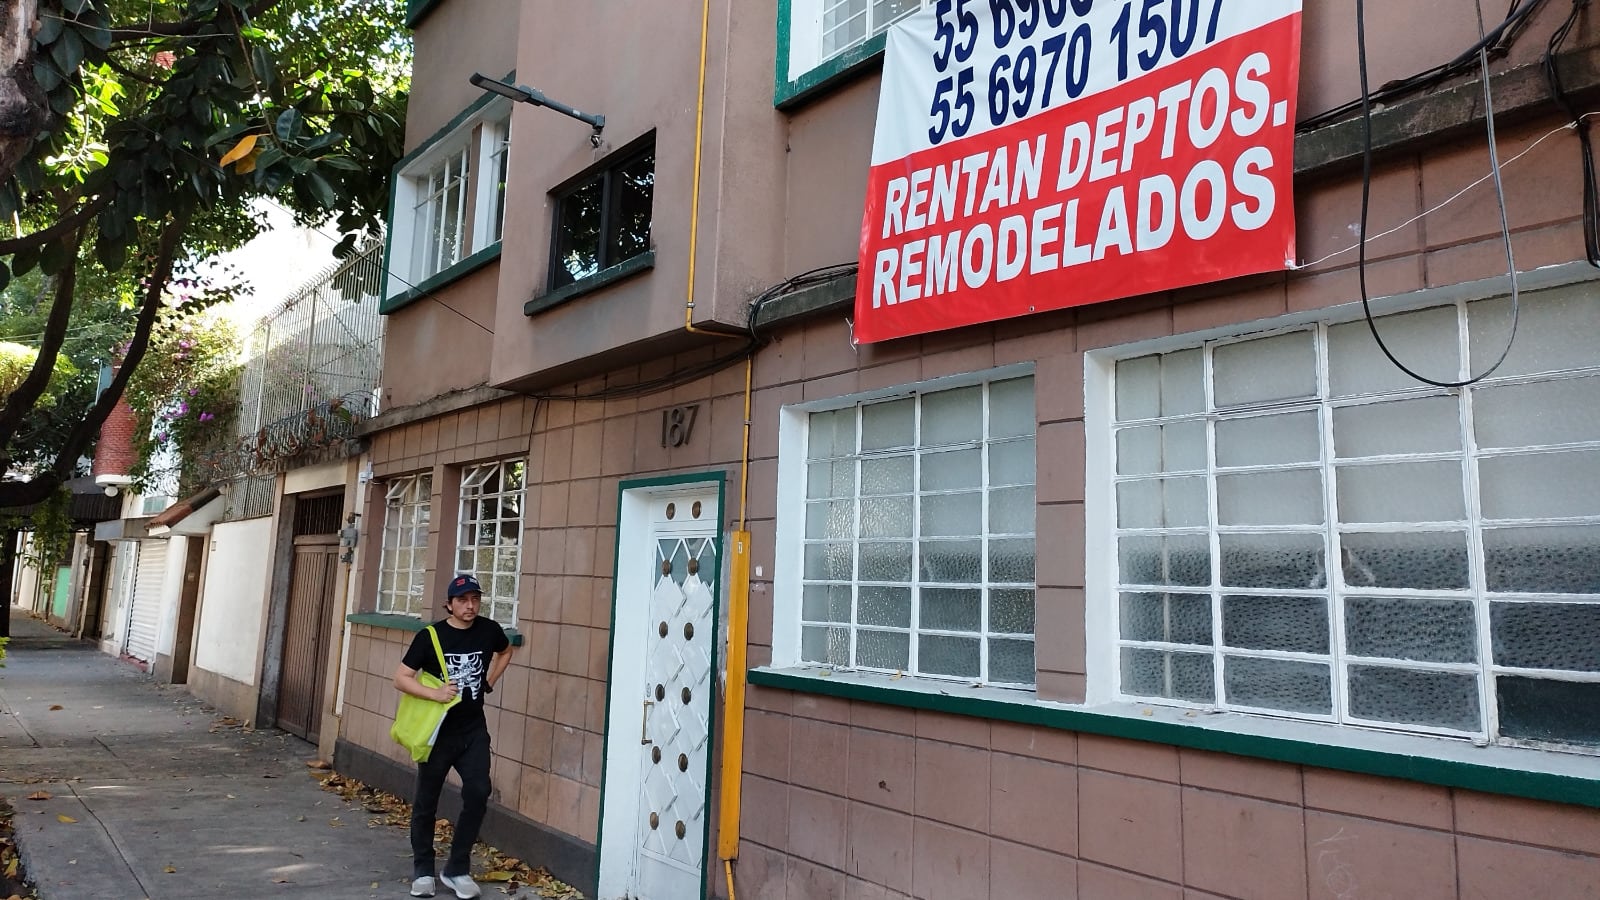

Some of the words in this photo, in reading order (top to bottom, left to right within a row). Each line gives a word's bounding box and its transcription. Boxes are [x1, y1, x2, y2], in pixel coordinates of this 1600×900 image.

[928, 66, 976, 145] 55
[987, 22, 1092, 127] 6970
[1109, 0, 1223, 82] 1507
[933, 0, 979, 73] 55
[988, 0, 1094, 49] 69
[882, 133, 1047, 240] RENTAN
[1056, 51, 1288, 193] DEPTOS.
[872, 146, 1276, 309] REMODELADOS
[661, 404, 700, 449] 187
